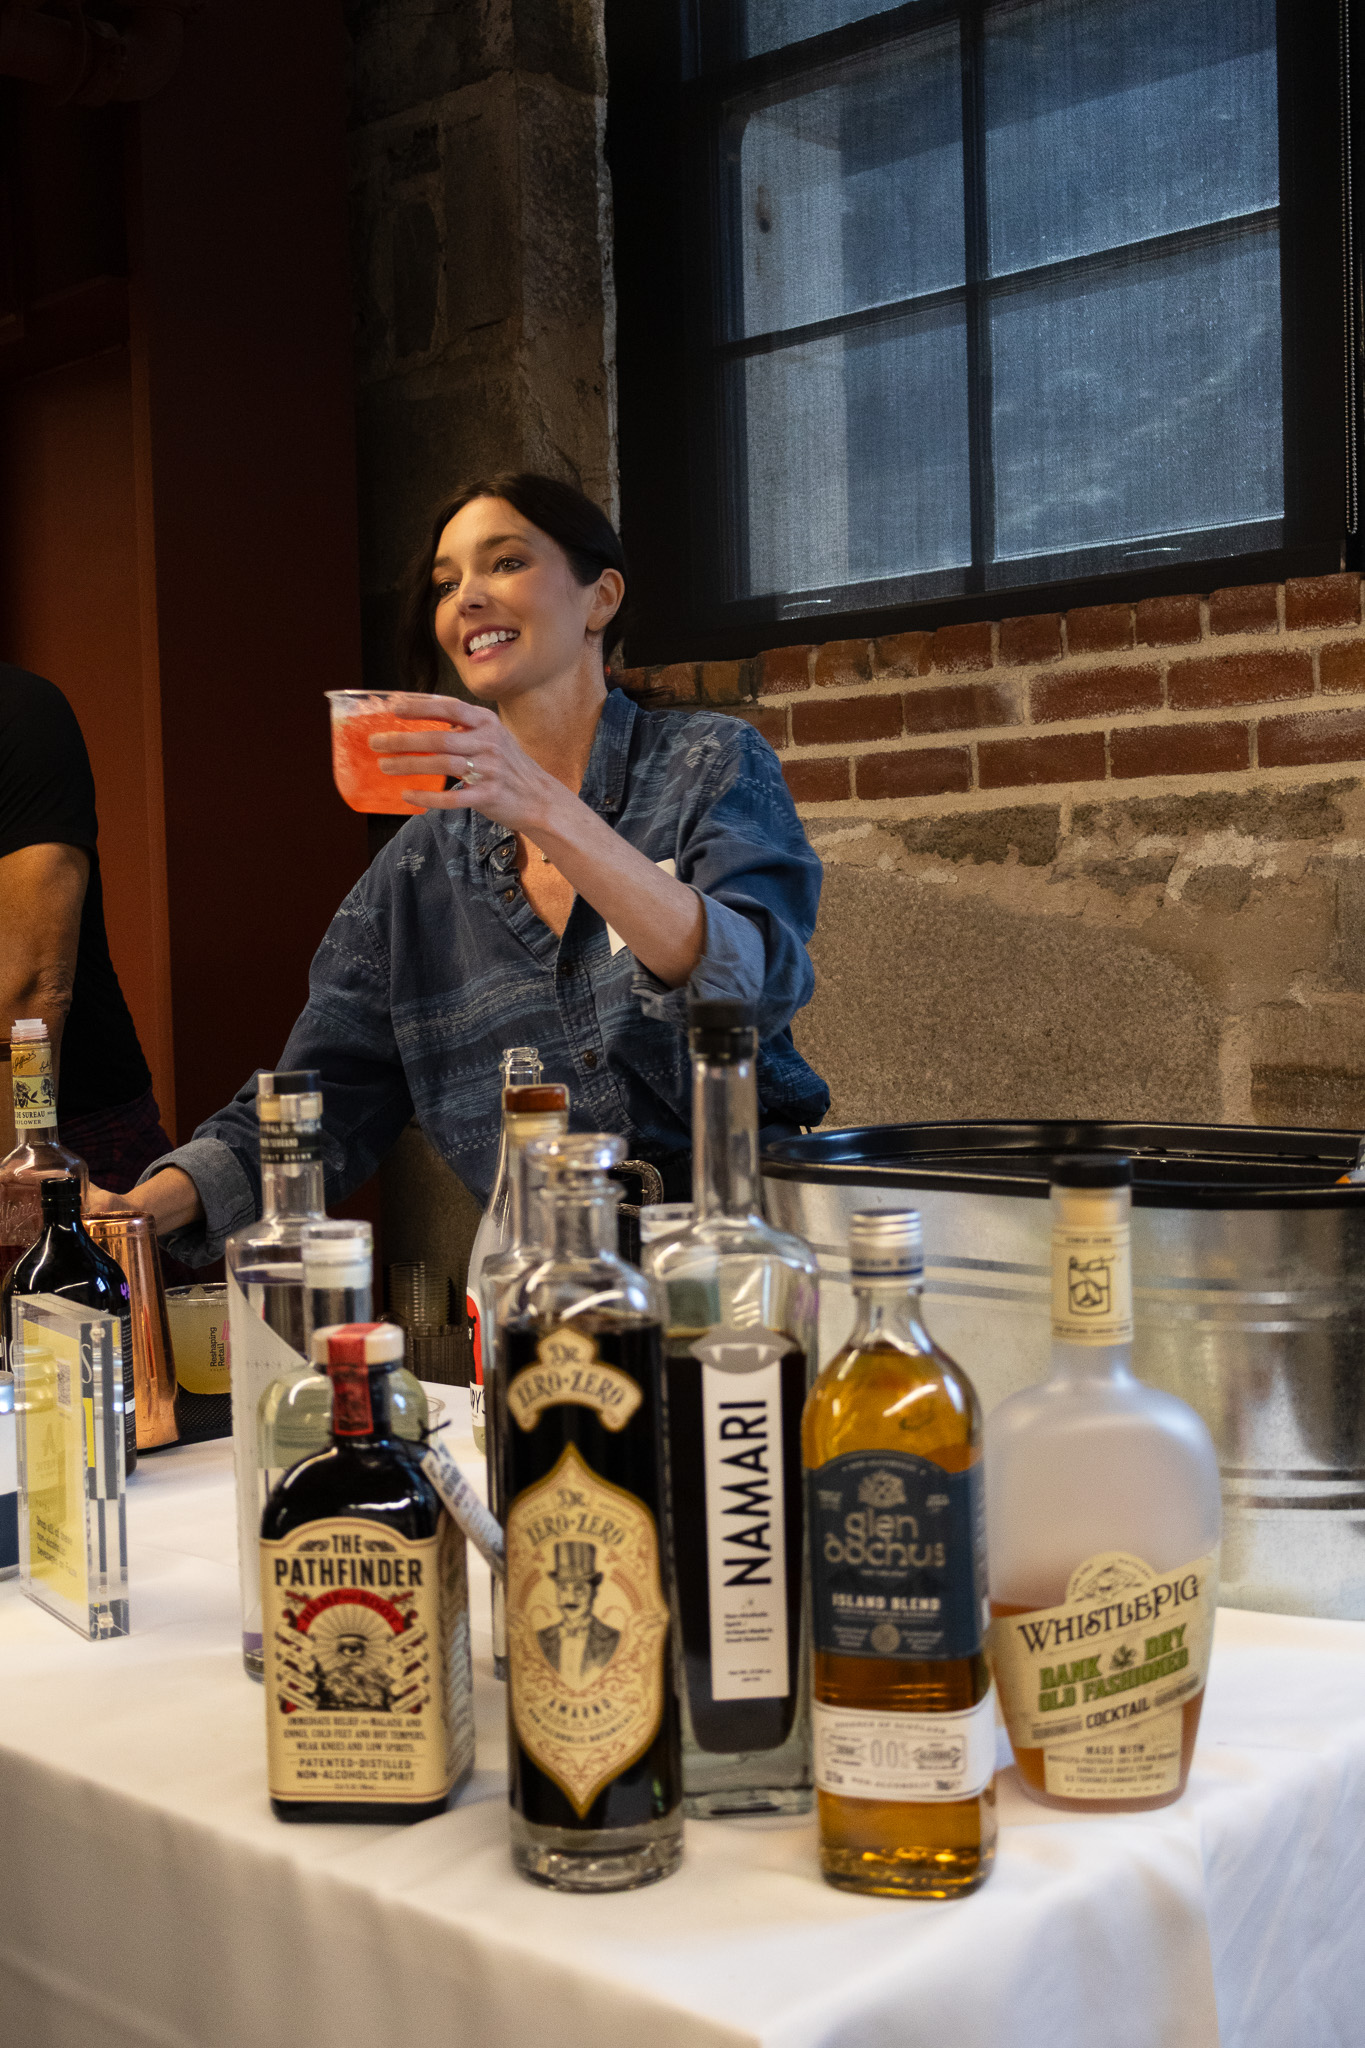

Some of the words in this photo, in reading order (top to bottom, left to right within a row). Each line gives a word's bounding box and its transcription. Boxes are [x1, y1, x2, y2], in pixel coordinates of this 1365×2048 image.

[22, 1111, 46, 1119] SUREAU
[719, 1400, 773, 1587] NAMARI
[331, 1534, 362, 1555] THE
[274, 1558, 423, 1587] PATHFINDER
[1017, 1574, 1199, 1653] WHISTLEPIG
[1038, 1686, 1077, 1713] OLD
[1082, 1647, 1190, 1705] FASHIONED
[1085, 1698, 1151, 1730] COCKTAIL
[296, 1771, 379, 1781] NON-ALCOHOLIC
[382, 1771, 416, 1782] SPIRIT
